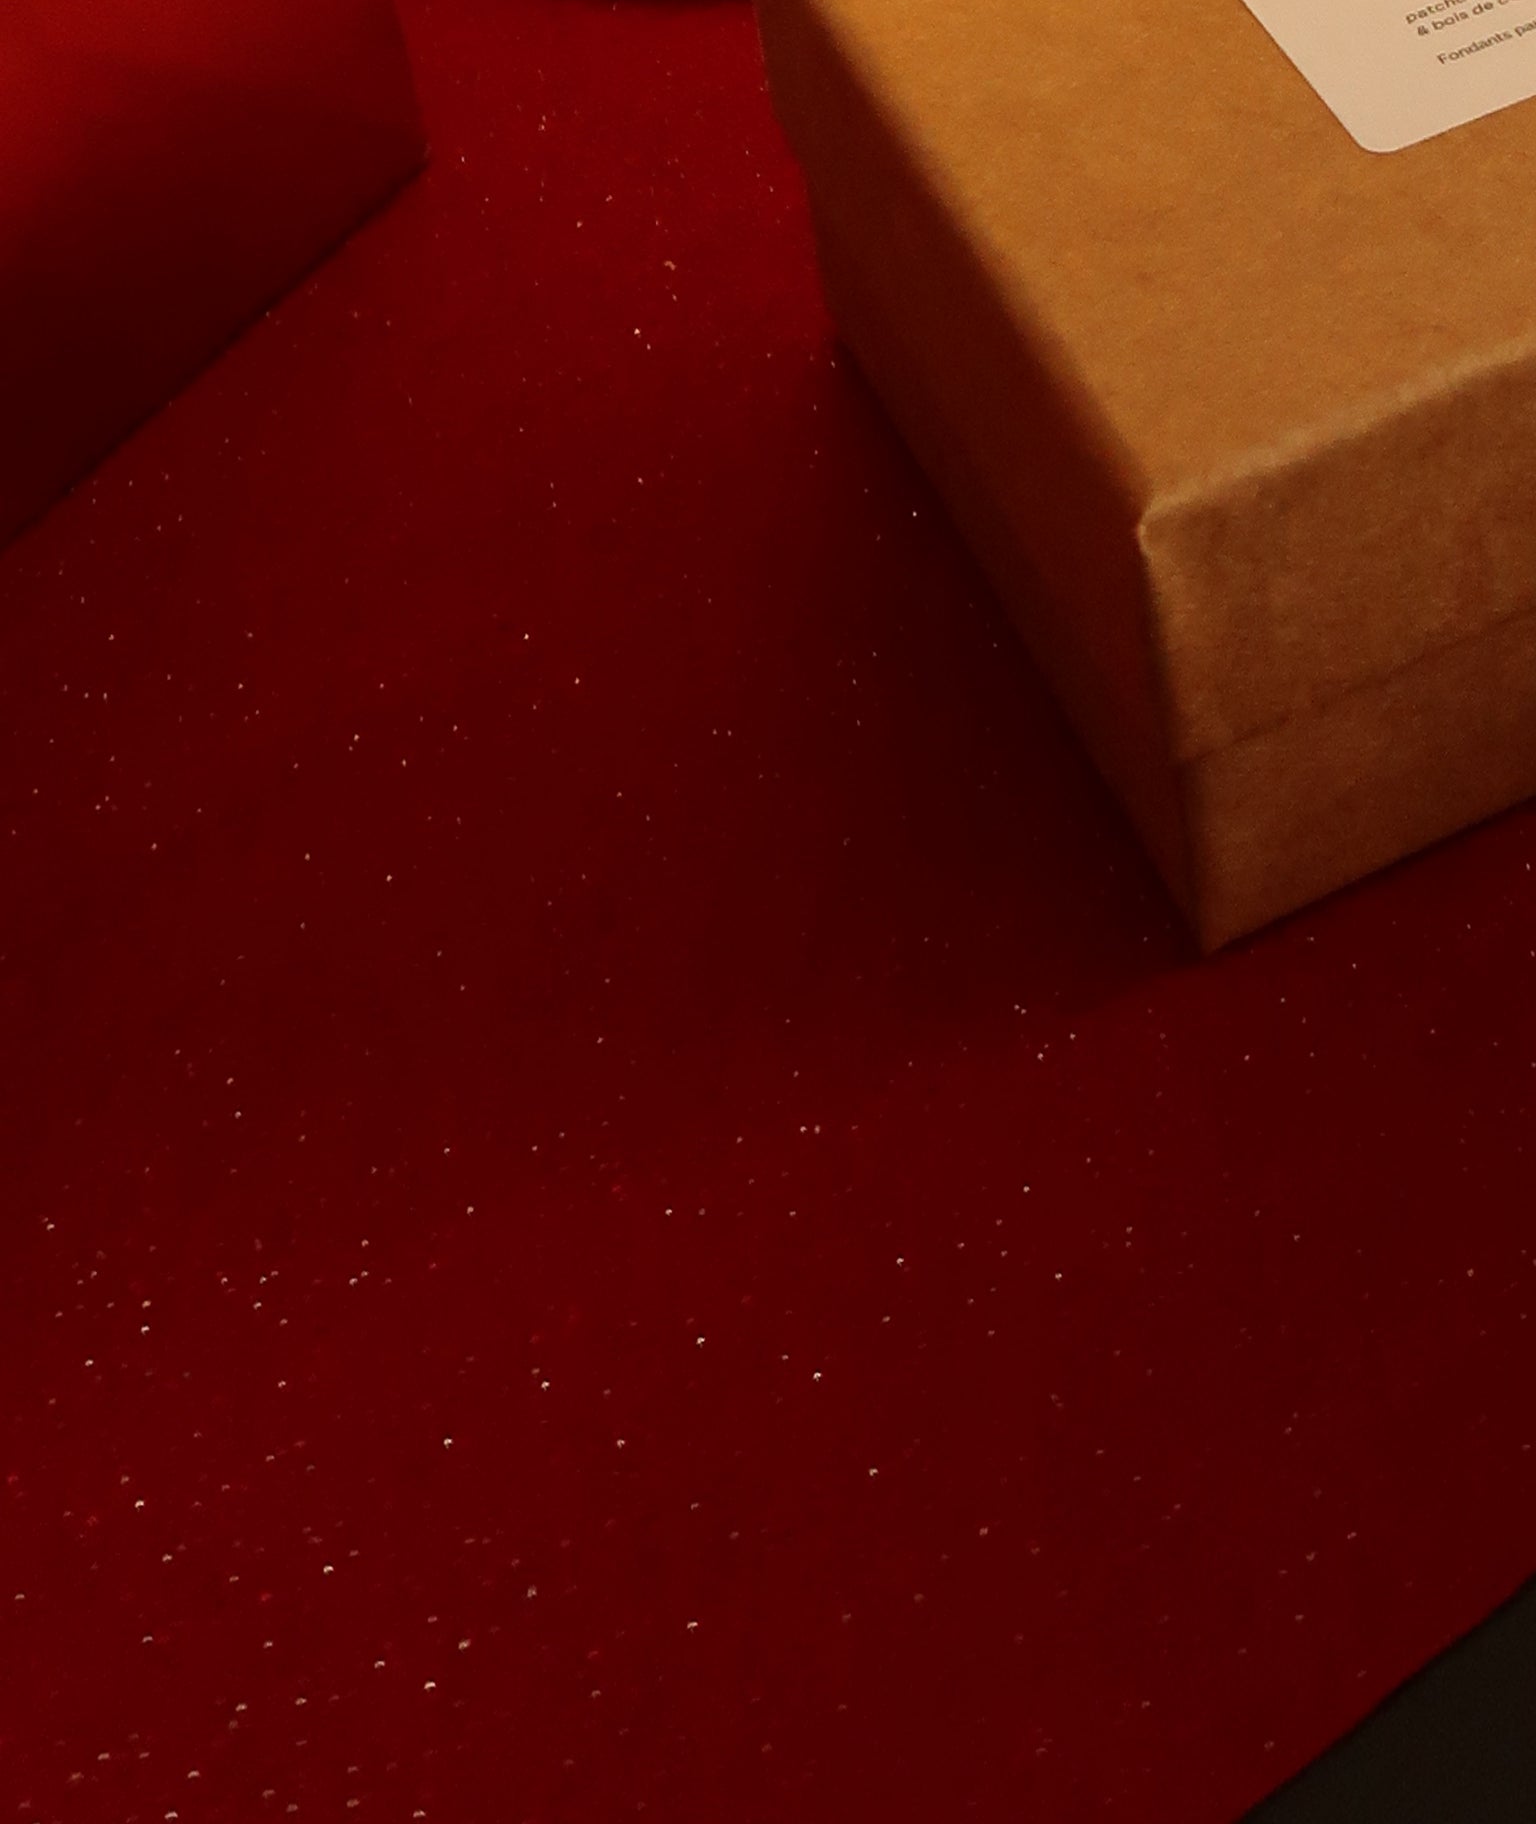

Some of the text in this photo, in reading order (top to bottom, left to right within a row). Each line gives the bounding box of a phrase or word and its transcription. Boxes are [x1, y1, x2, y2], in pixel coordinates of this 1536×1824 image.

[1416, 24, 1430, 37] &
[1431, 10, 1469, 31] bois
[1471, 0, 1494, 16] de
[1436, 28, 1514, 65] Fondants
